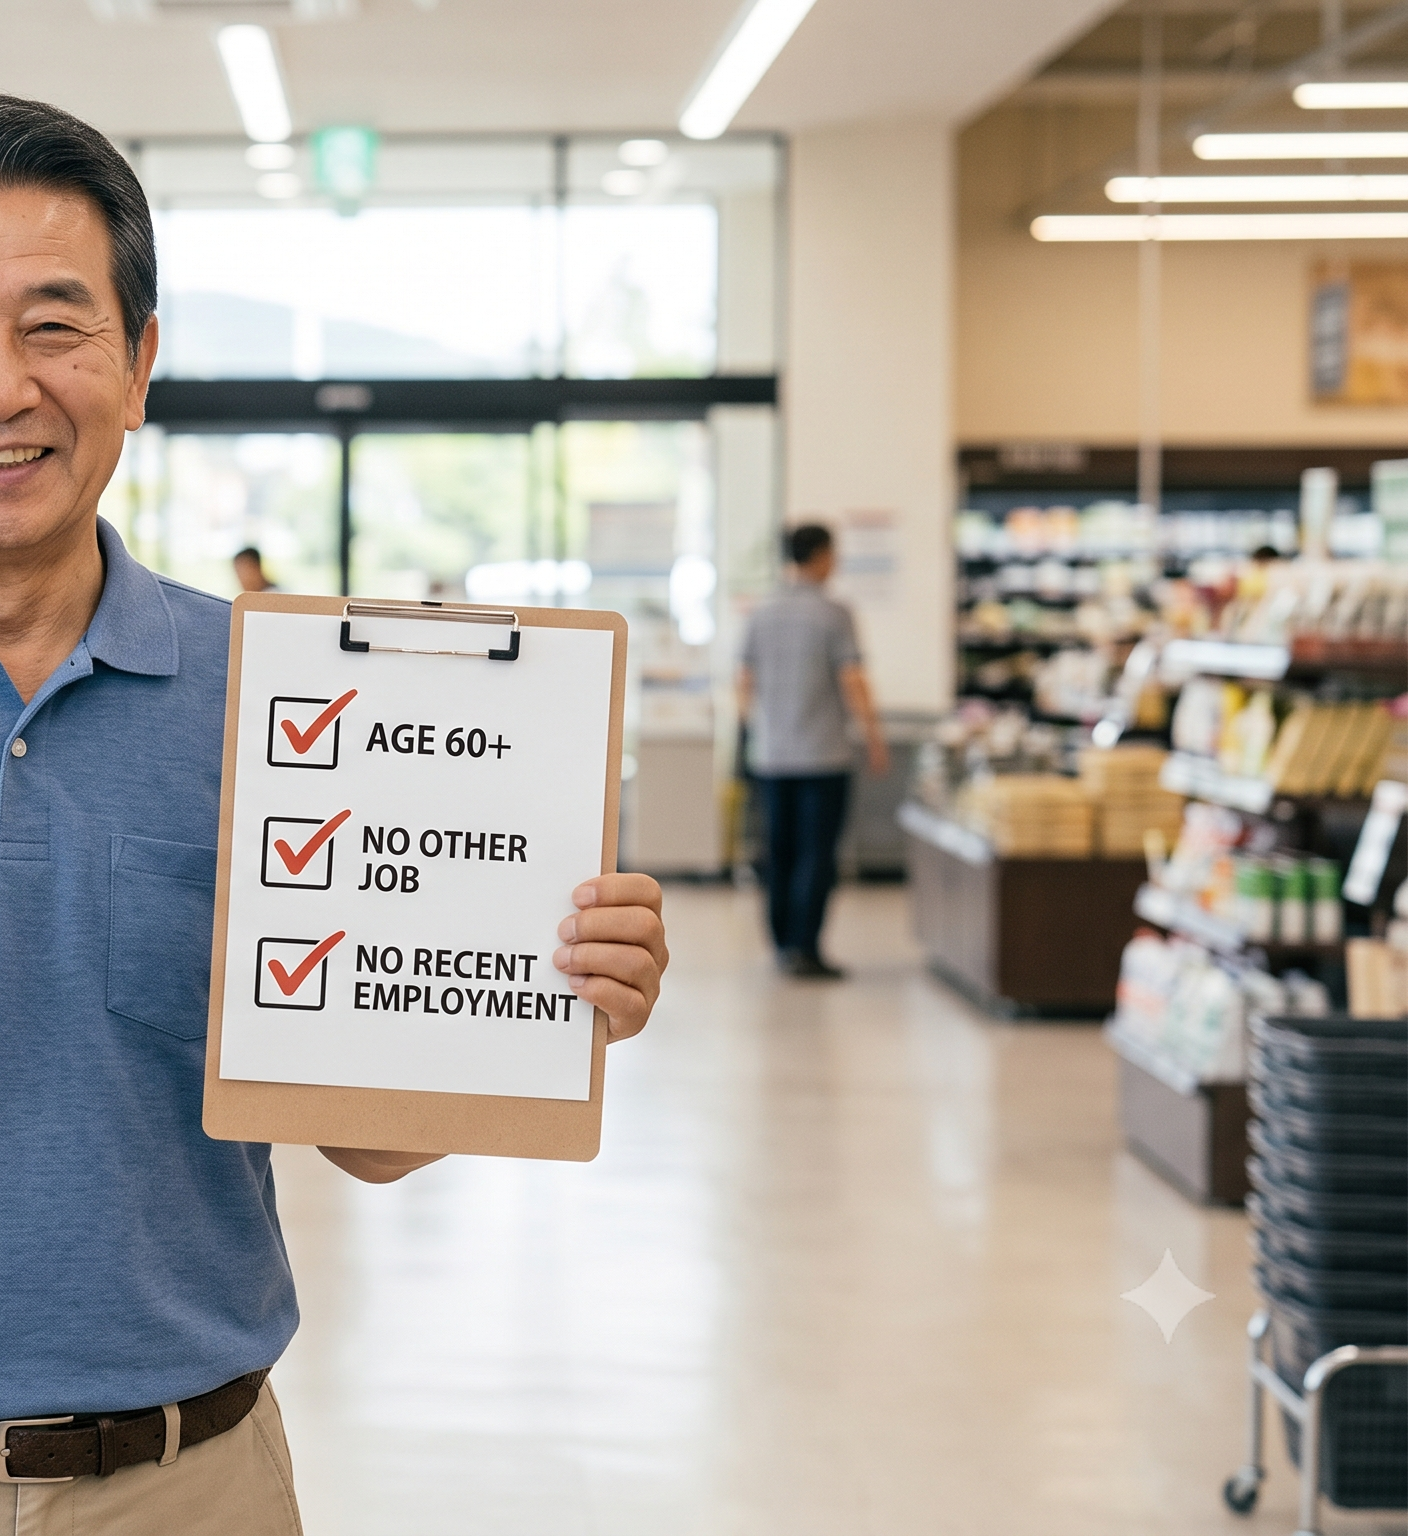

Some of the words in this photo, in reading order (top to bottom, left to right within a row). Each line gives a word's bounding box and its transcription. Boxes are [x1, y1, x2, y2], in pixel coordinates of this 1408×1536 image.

[365, 722, 436, 755] AGE
[445, 727, 512, 760] 60+
[362, 825, 411, 856] NO
[419, 829, 528, 863] OTHER
[357, 862, 420, 894] JOB
[356, 944, 404, 975] NO
[413, 948, 538, 983] RECENT
[353, 981, 578, 1022] EMPLOYMENT
